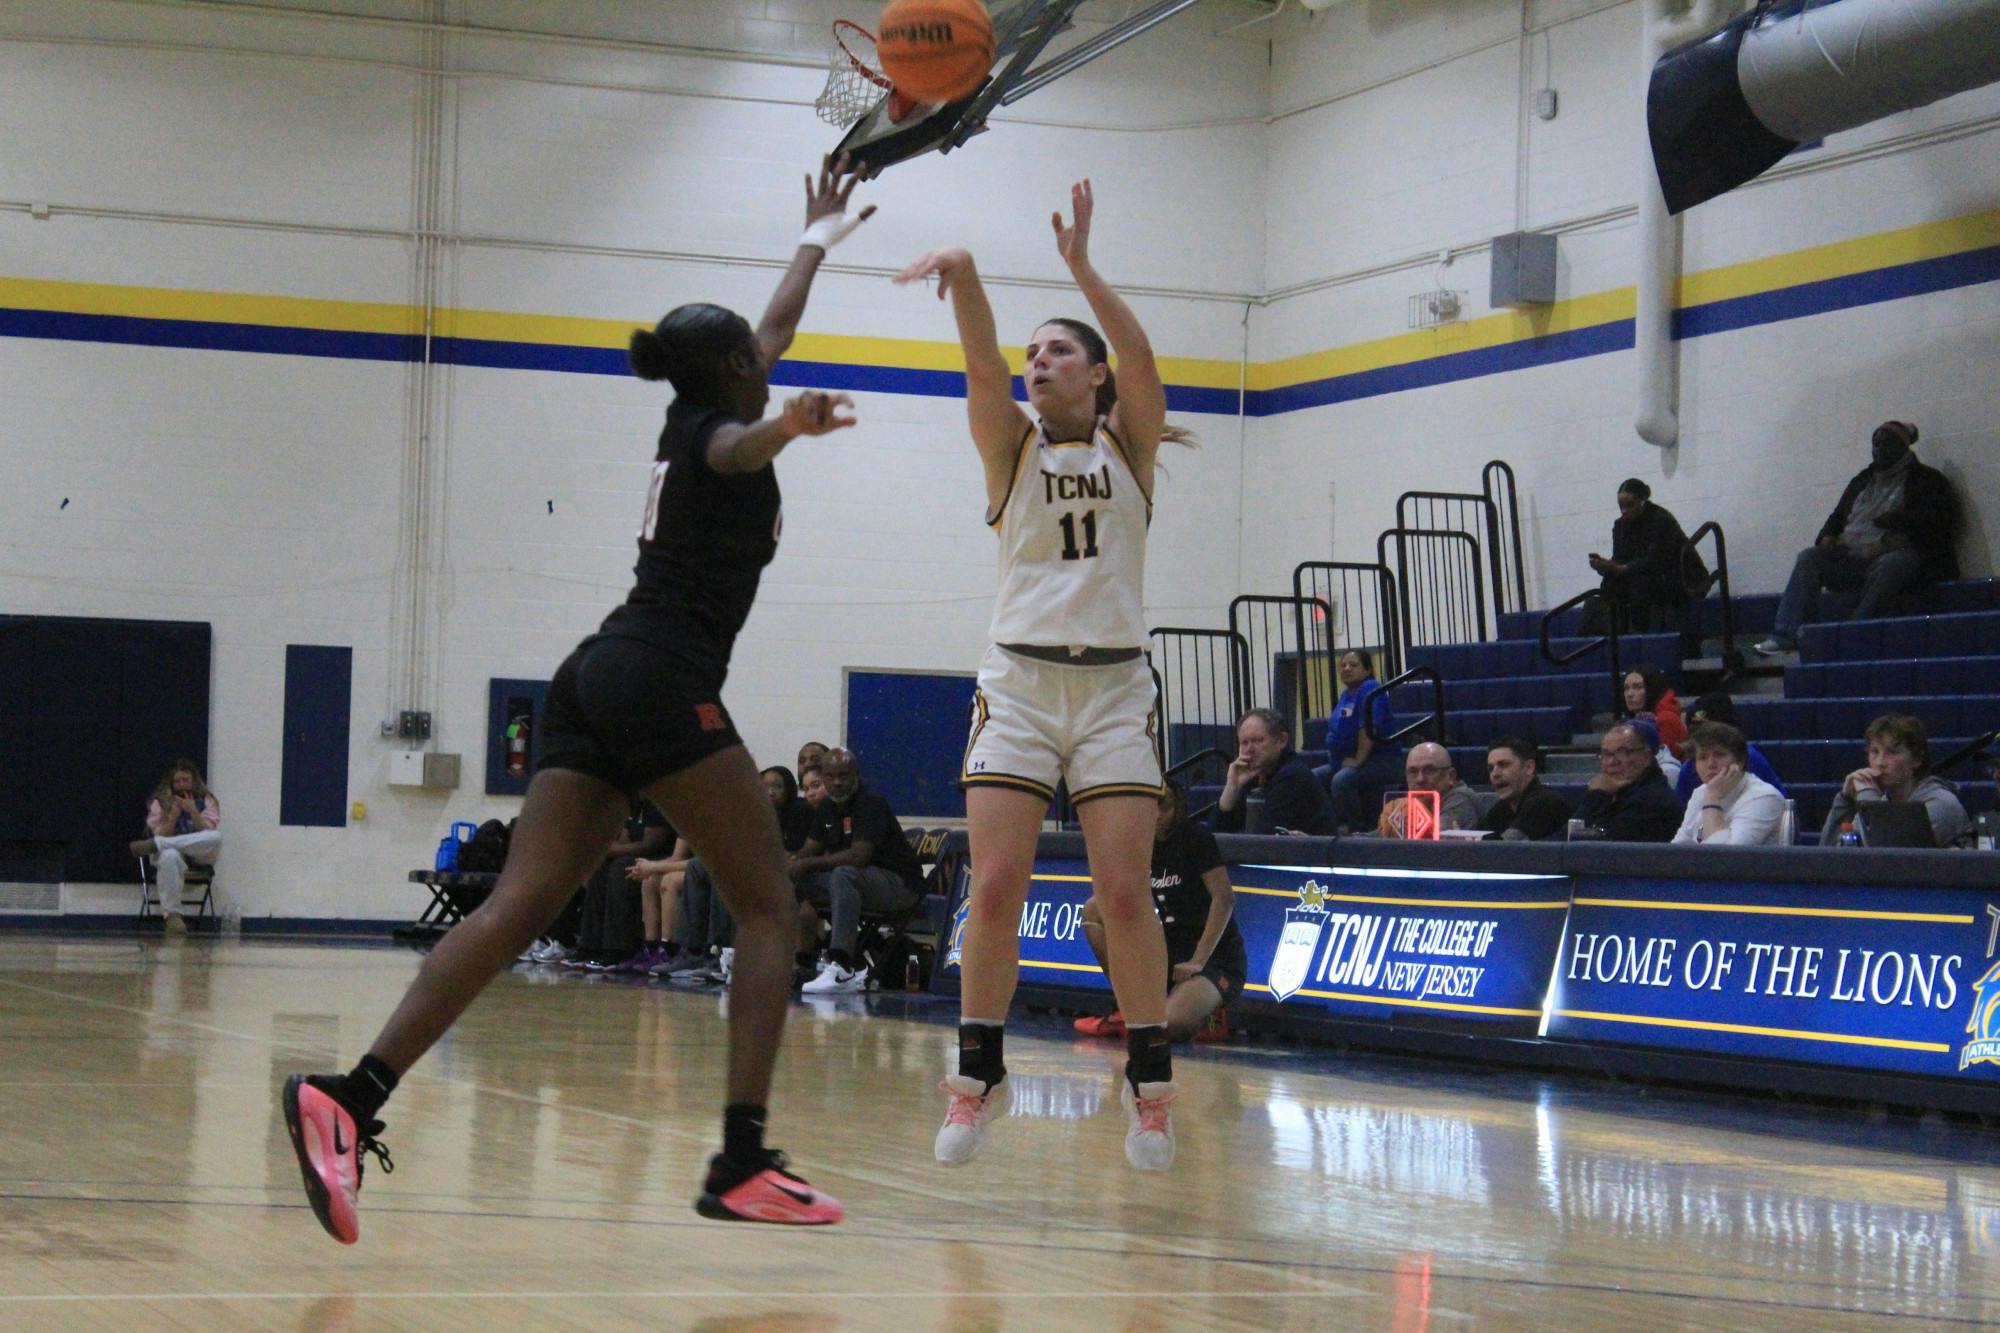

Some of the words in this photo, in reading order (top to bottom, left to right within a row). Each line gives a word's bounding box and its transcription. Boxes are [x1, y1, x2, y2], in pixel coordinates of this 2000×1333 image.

[1040, 464, 1113, 505] TCNJ
[1058, 510, 1099, 561] 11
[1017, 901, 1052, 939] ME
[1053, 902, 1085, 941] OF
[1392, 917, 1423, 953] THE
[1421, 919, 1478, 958] COLLEGE
[1475, 921, 1498, 958] OF
[1316, 912, 1397, 988] TCNJ
[1378, 960, 1426, 991] NEW
[1416, 963, 1485, 1000] JERSEY
[1568, 932, 1677, 988] HOME
[1684, 938, 1738, 992] OF
[1744, 941, 1825, 999] THE
[1830, 946, 1962, 1011] LIONS
